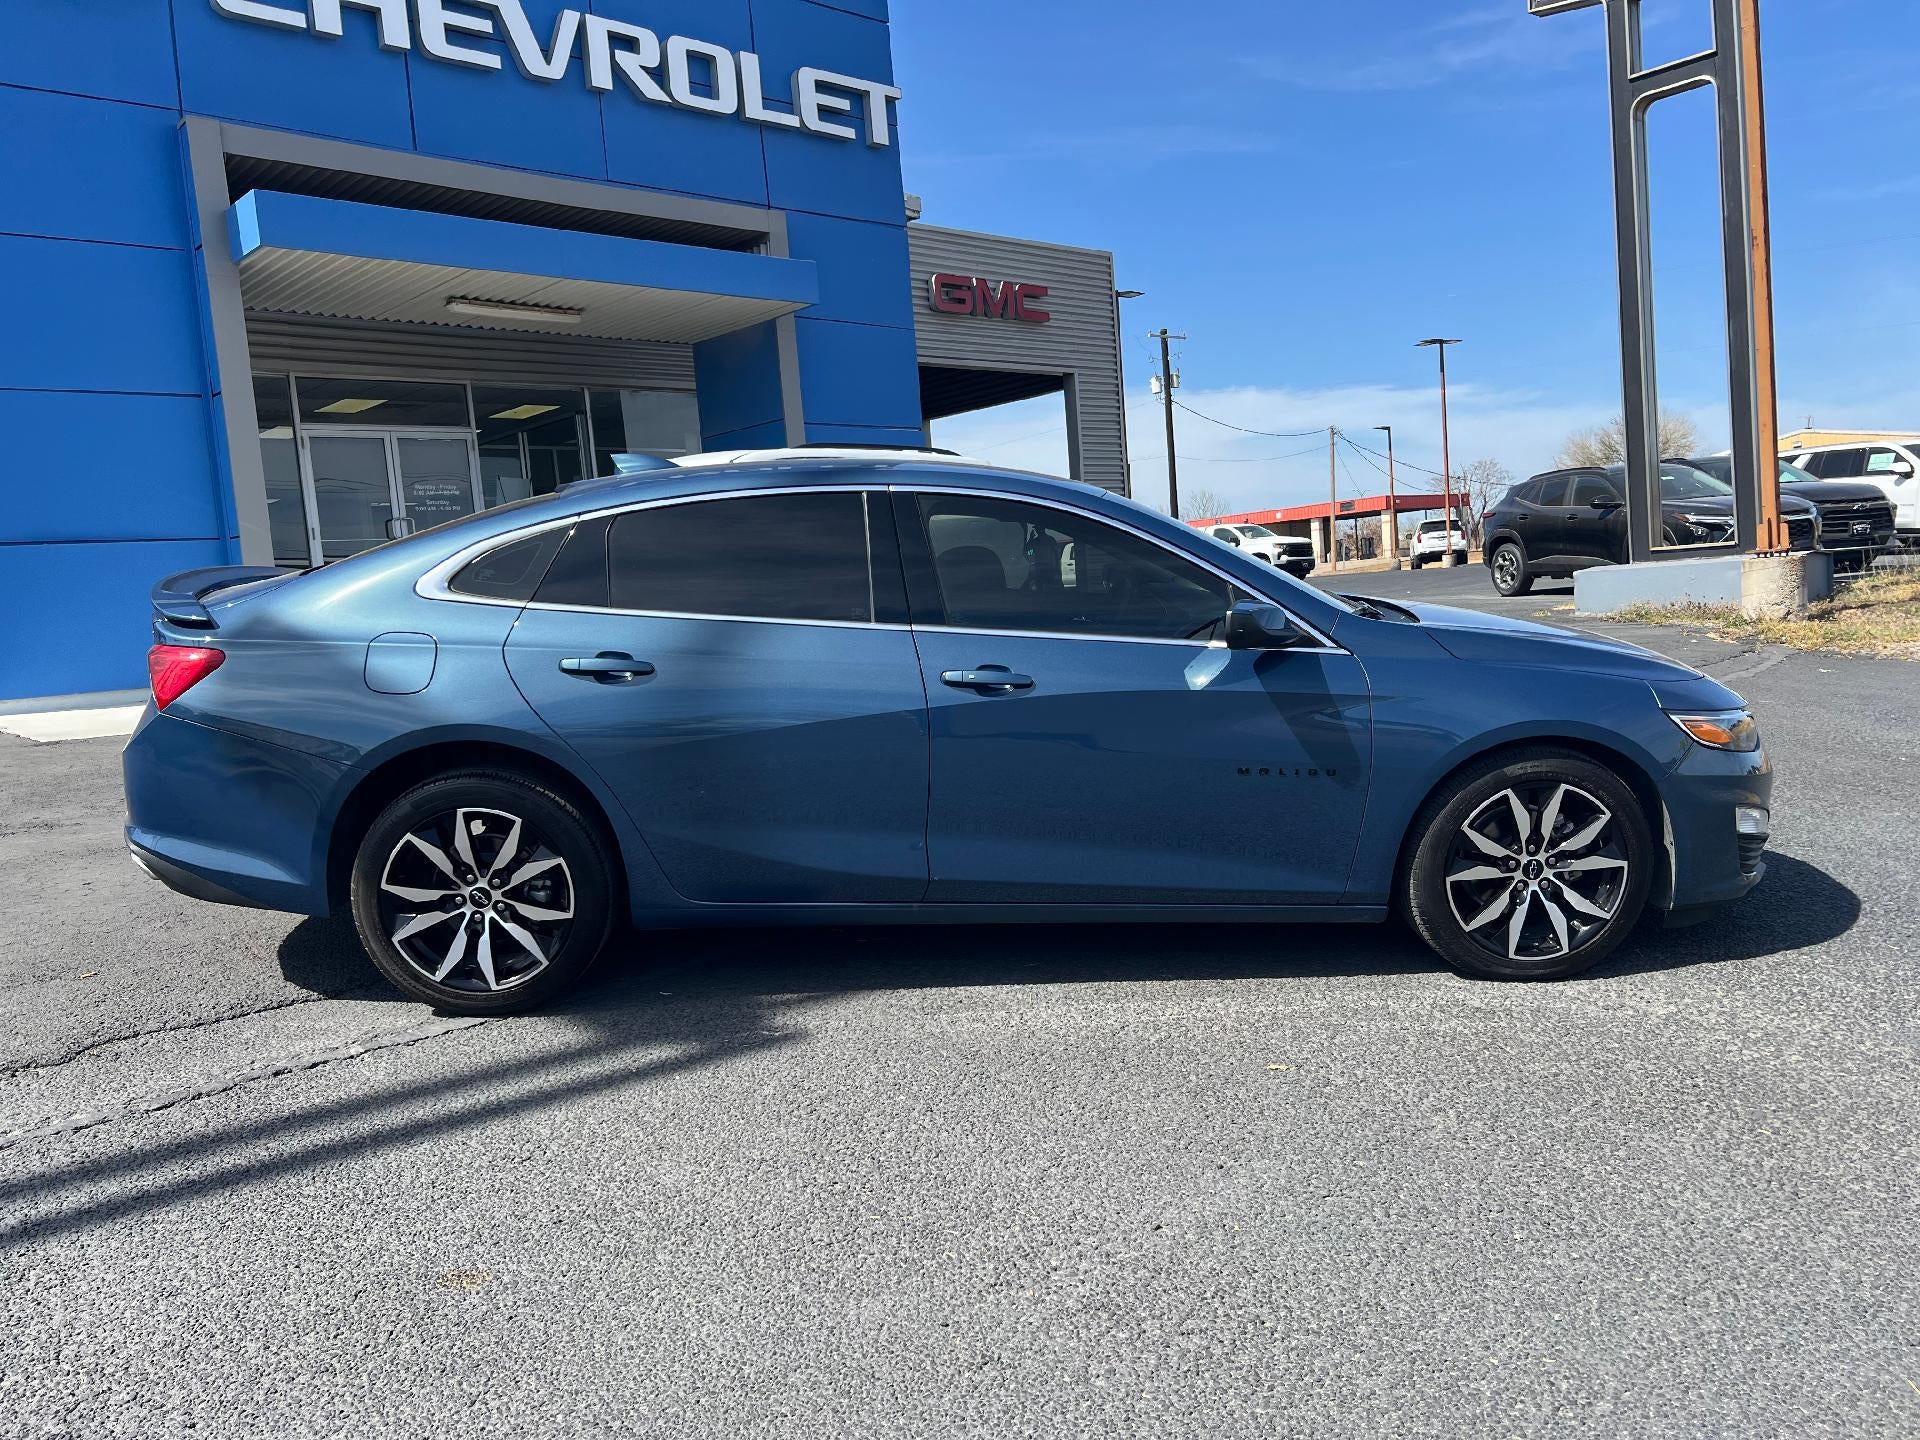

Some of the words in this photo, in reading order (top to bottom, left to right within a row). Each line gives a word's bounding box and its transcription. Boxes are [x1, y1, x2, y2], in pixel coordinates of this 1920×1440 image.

[212, 0, 901, 148] HEVROLET
[929, 272, 1050, 323] GMC
[1237, 767, 1337, 777] MALIBU
